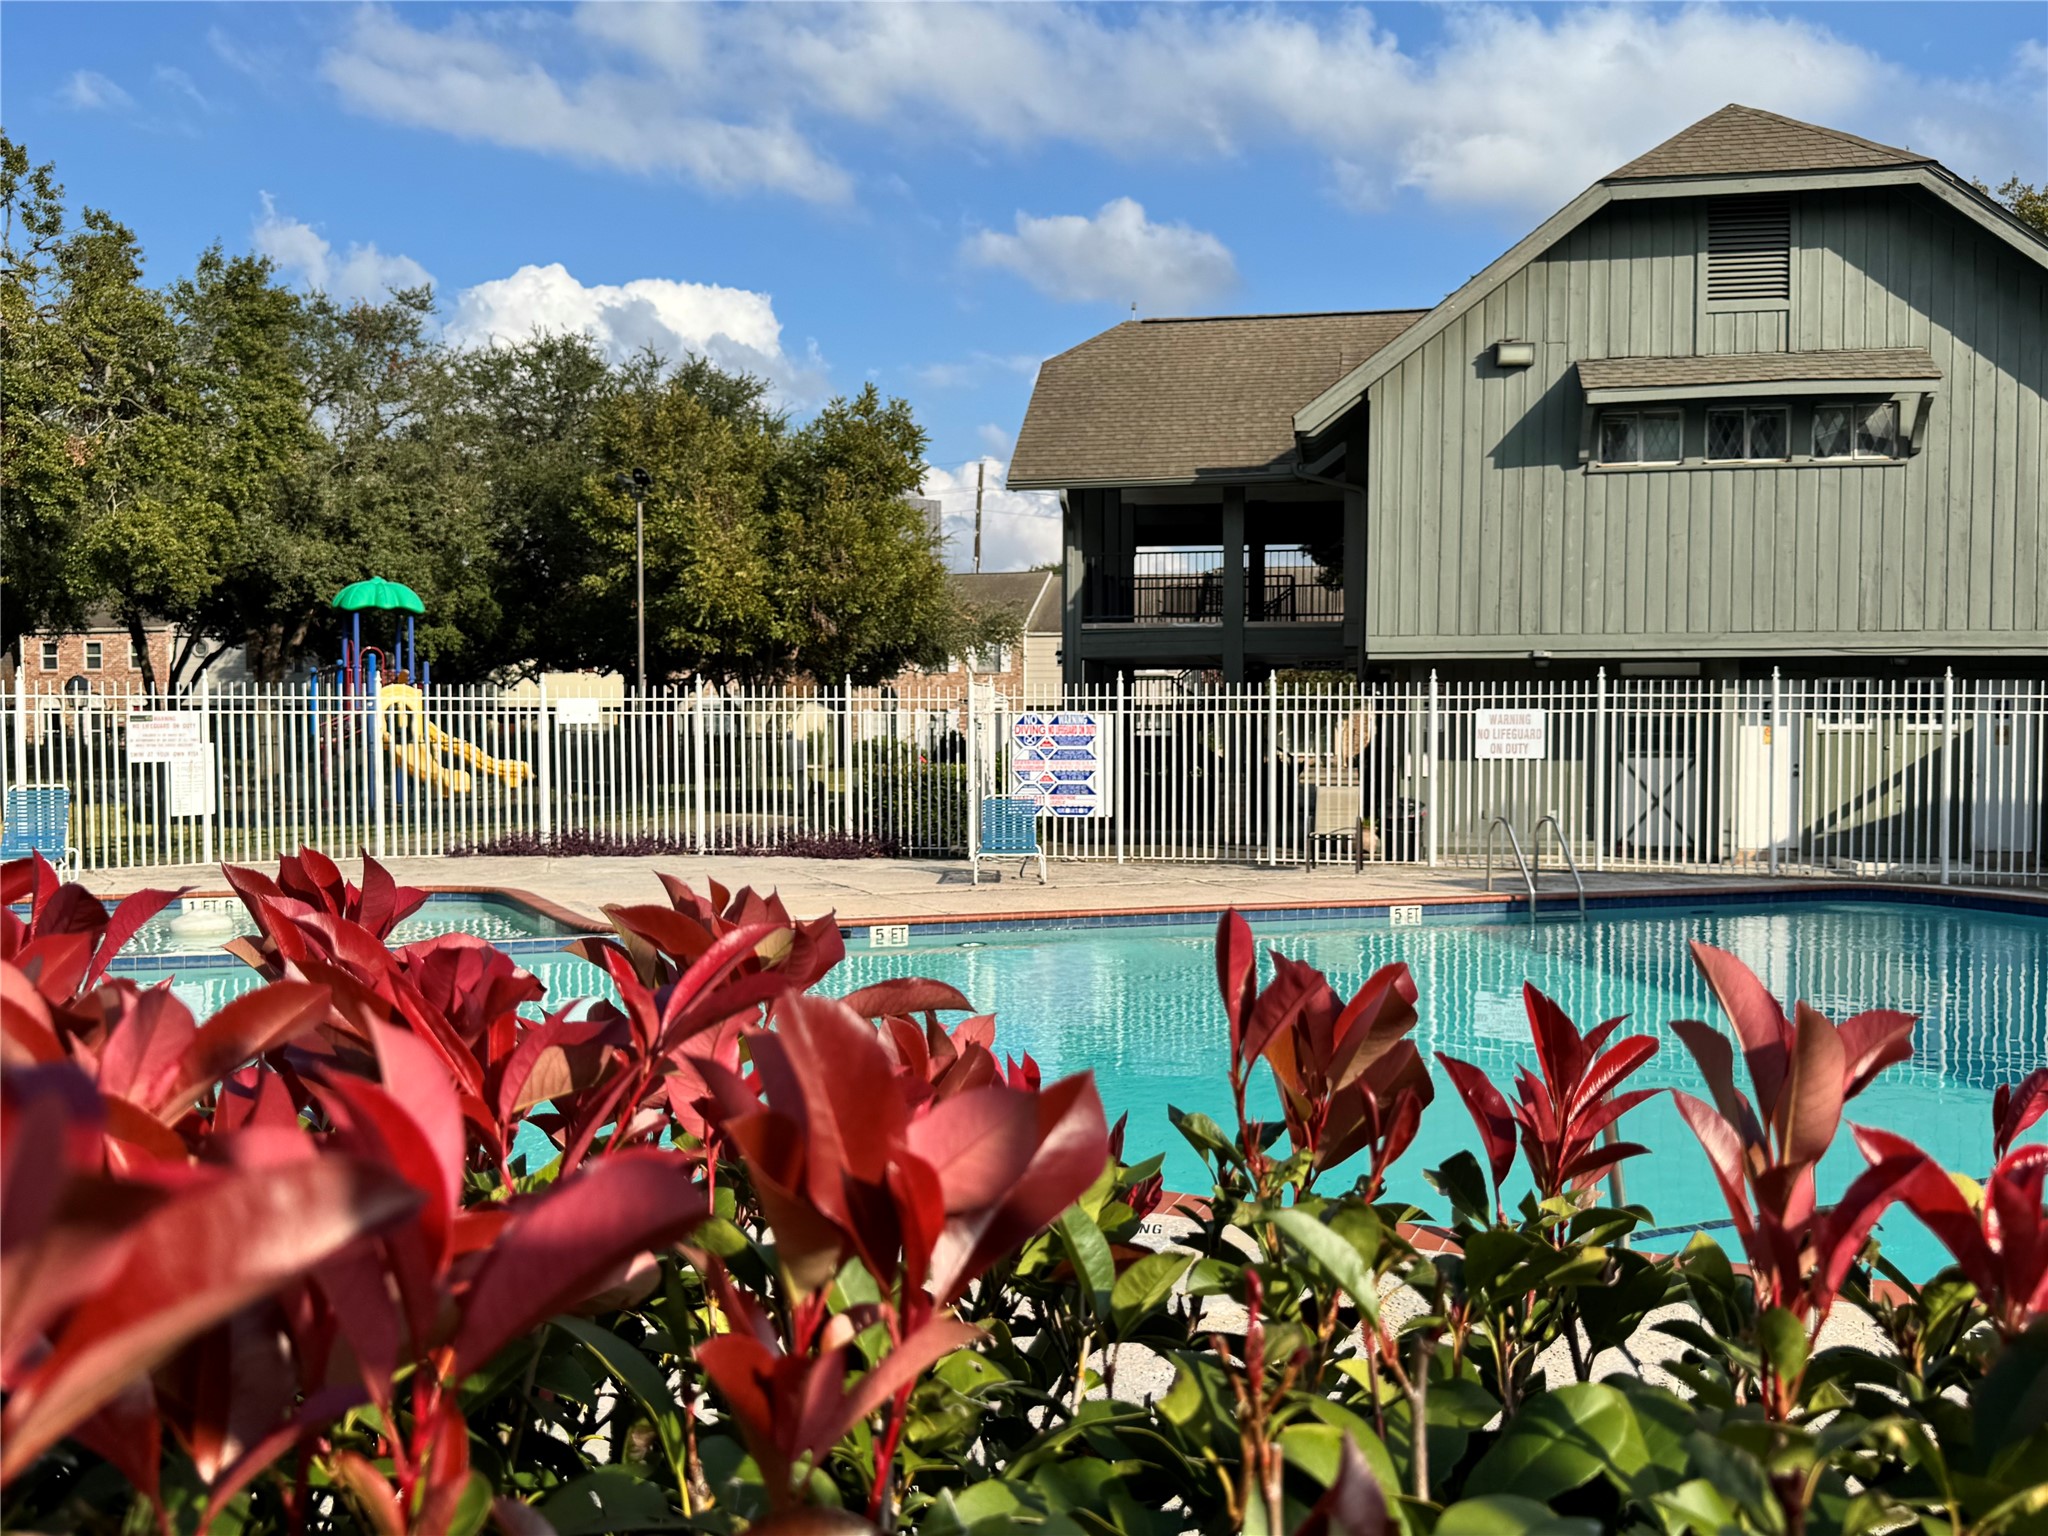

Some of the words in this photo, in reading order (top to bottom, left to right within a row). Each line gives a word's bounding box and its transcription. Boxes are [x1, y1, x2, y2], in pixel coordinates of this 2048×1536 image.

[1023, 714, 1038, 725] NO
[1058, 713, 1088, 725] WARNING
[1489, 713, 1531, 725] WARNING
[1014, 725, 1046, 735] DIVING
[1048, 725, 1055, 735] NO
[1477, 728, 1490, 740] NO
[1492, 728, 1542, 740] LIFEGUARD
[1490, 742, 1503, 754] ON
[1505, 742, 1529, 754] DUTY
[1139, 1223, 1162, 1234] NG
